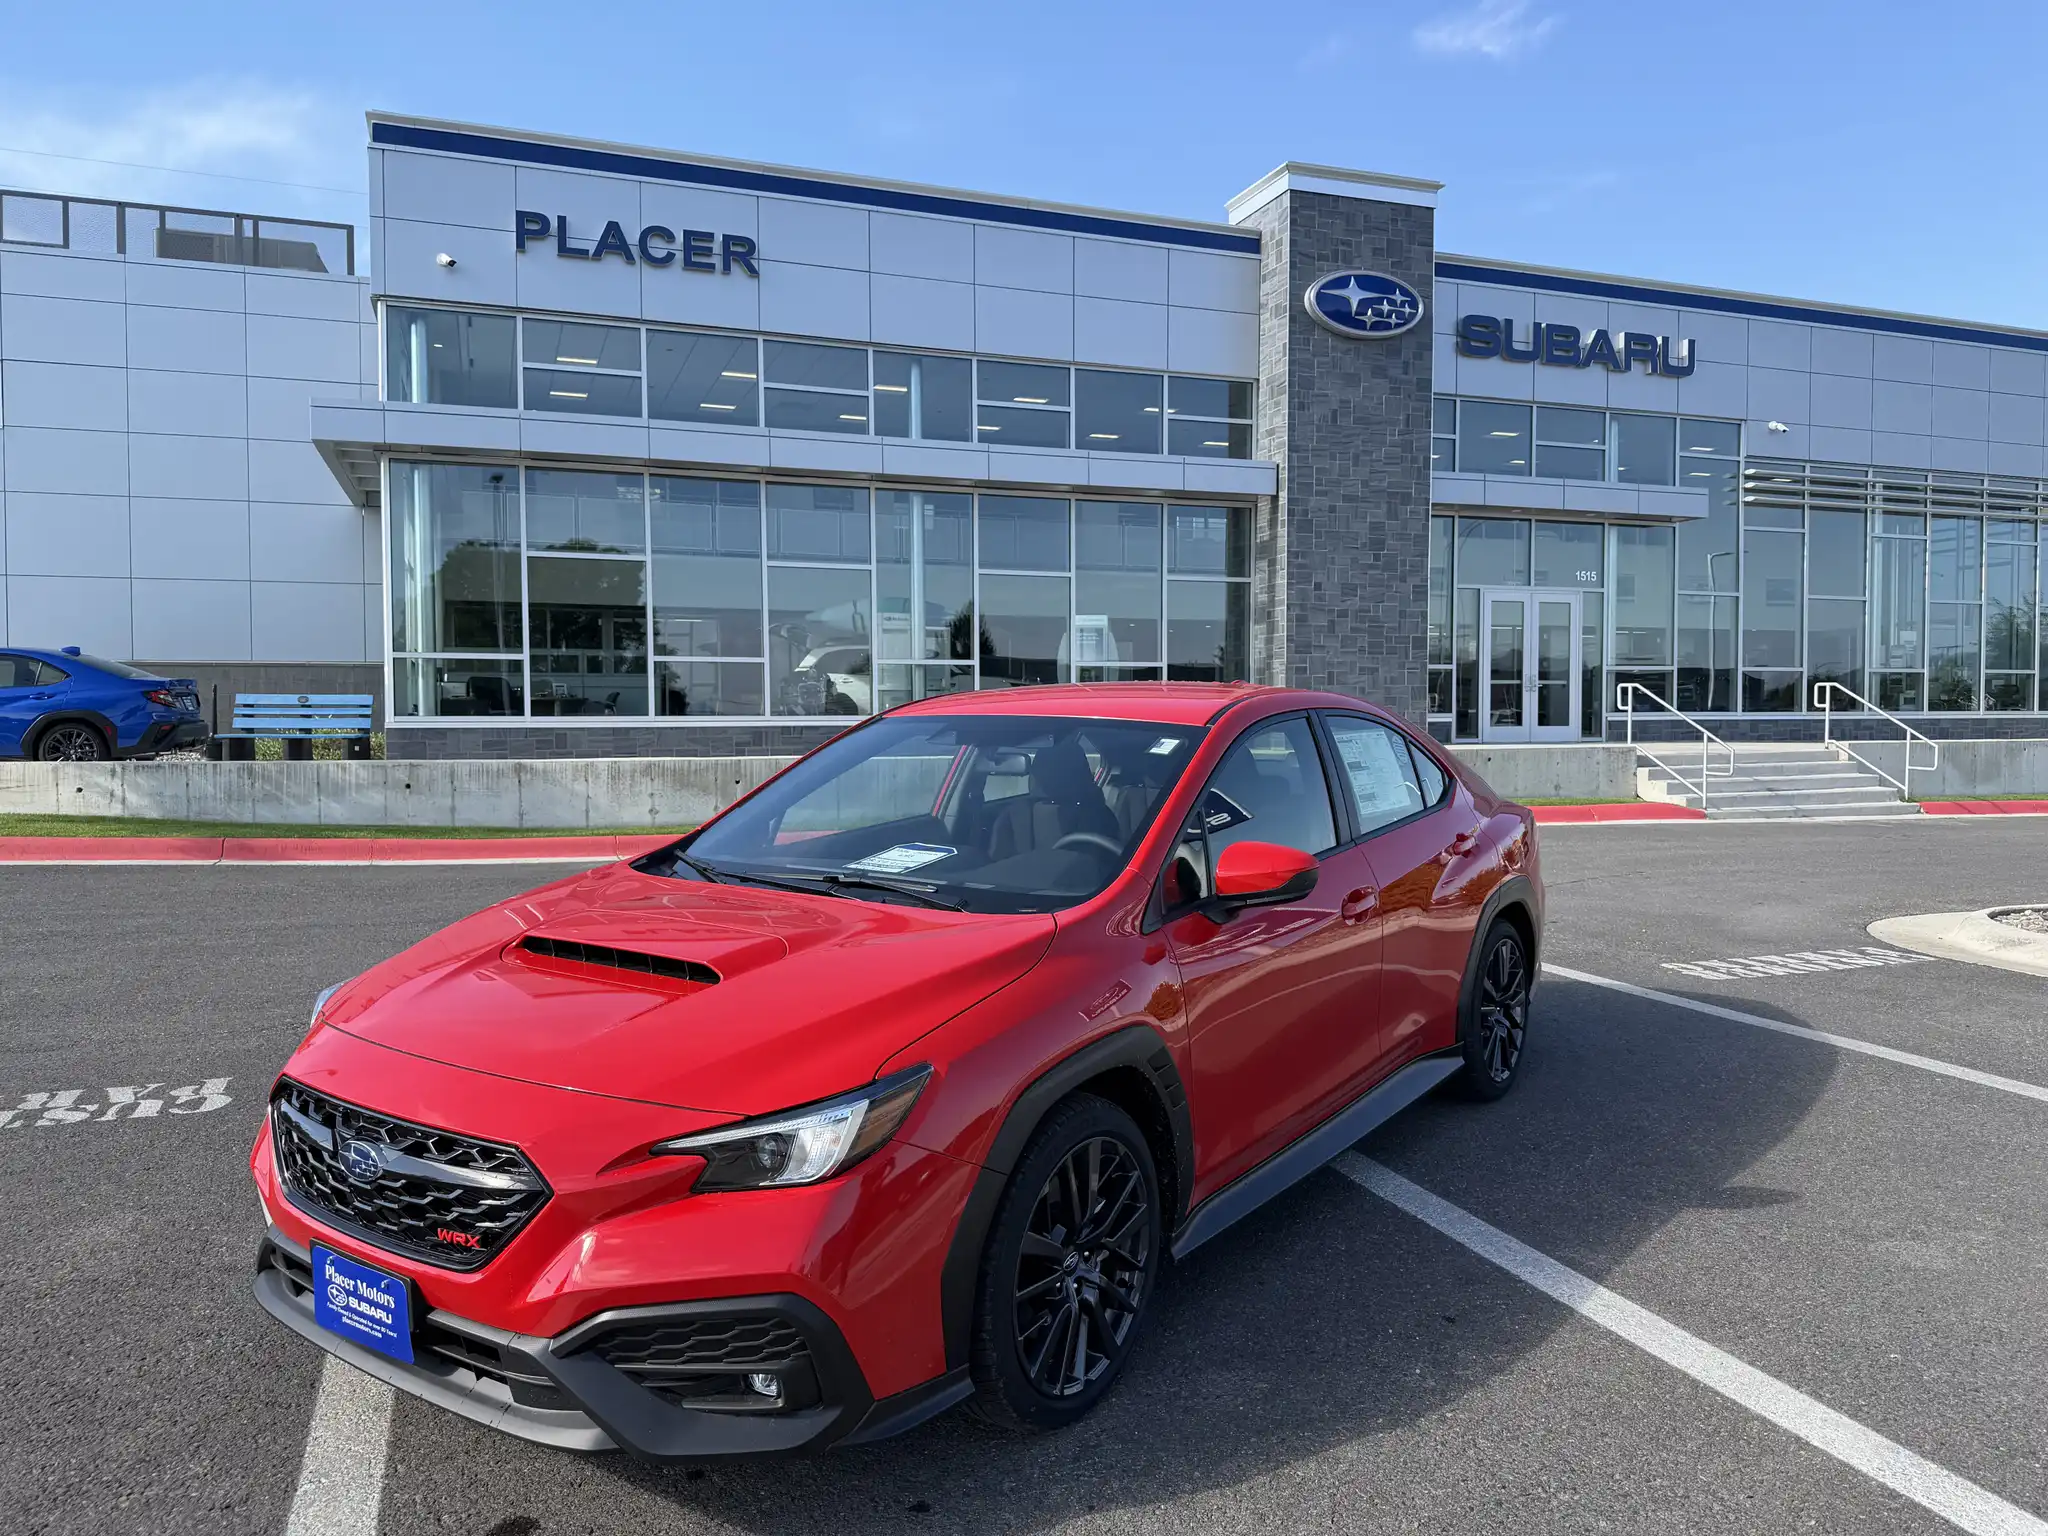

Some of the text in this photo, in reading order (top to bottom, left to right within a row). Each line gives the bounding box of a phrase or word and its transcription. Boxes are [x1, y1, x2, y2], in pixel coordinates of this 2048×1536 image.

[516, 210, 760, 276] PLACER
[1458, 314, 1696, 377] SUBARU
[1575, 570, 1597, 581] 1515
[437, 1227, 481, 1249] WRX
[325, 1264, 395, 1309] Placer Motors
[348, 1296, 392, 1325] SUBARU
